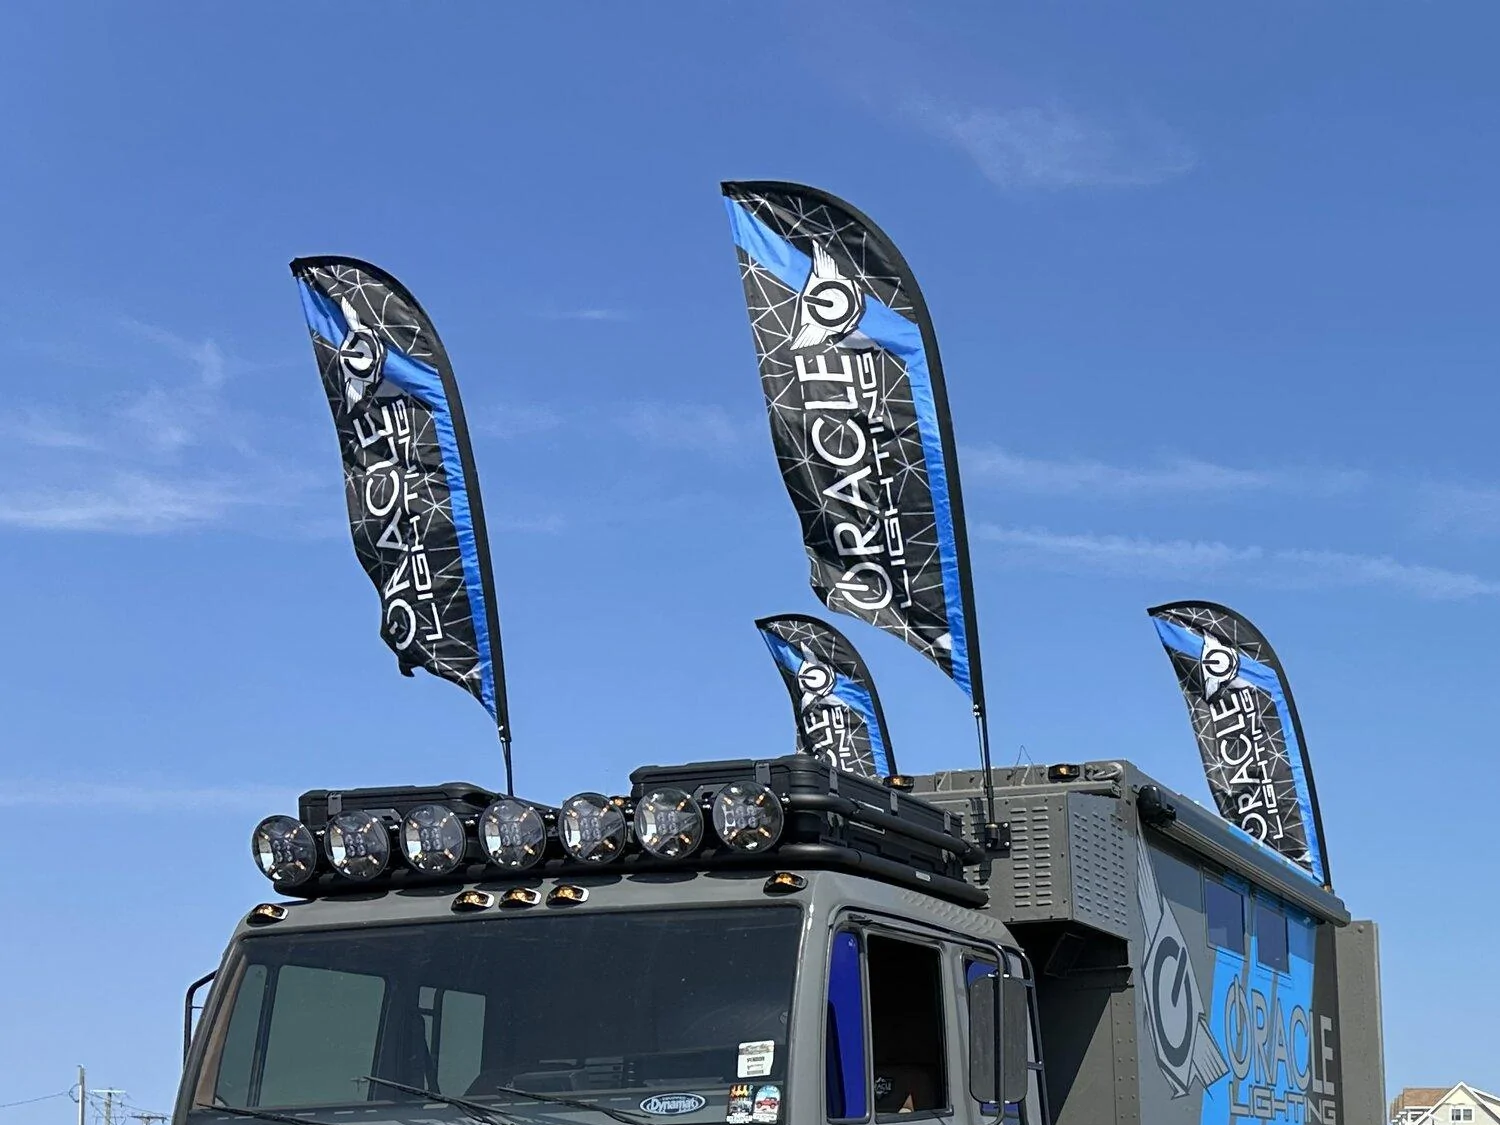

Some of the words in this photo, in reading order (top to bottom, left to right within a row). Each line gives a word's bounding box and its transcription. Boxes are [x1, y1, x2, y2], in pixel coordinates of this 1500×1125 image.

[392, 399, 443, 641] LIGHTING
[795, 355, 894, 610] ORACLE
[856, 352, 912, 608] LIGHTING
[1240, 688, 1283, 839] LIGHTING
[1225, 974, 1335, 1096] ORACLE
[1229, 1082, 1336, 1125] LIGHTING
